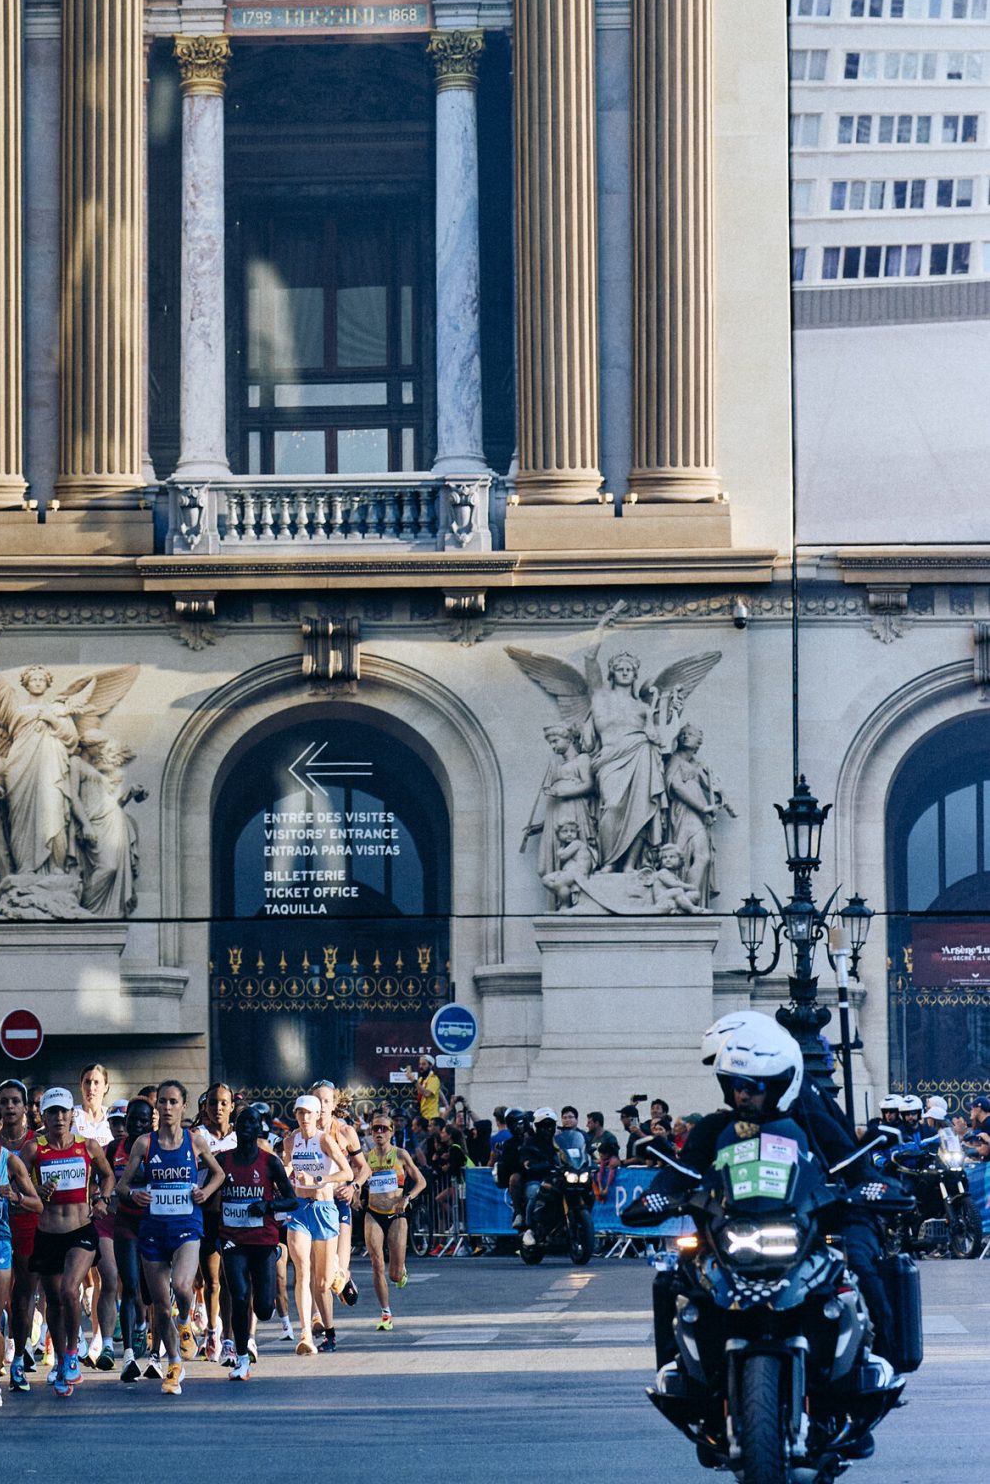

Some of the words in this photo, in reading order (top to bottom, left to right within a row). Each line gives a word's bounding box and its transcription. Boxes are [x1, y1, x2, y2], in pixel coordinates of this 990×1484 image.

[389, 8, 417, 22] 1868
[263, 811, 314, 824] ENTRÉE
[317, 812, 342, 823] DES
[345, 812, 395, 823] VISITES
[264, 828, 327, 840] VISITORS'
[329, 828, 400, 839] ENTRANCE
[263, 845, 319, 857] ENTRADA
[321, 844, 353, 856] PARA
[356, 844, 400, 856] VISITAS
[263, 870, 346, 882] BILLETTERIE
[264, 887, 310, 898] TICKET
[312, 886, 359, 898] OFFICE
[264, 903, 328, 915] TAQUILLA
[376, 1046, 432, 1054] DEVIALET
[151, 1166, 191, 1180] FRANCE
[155, 1194, 189, 1205] JULIEN
